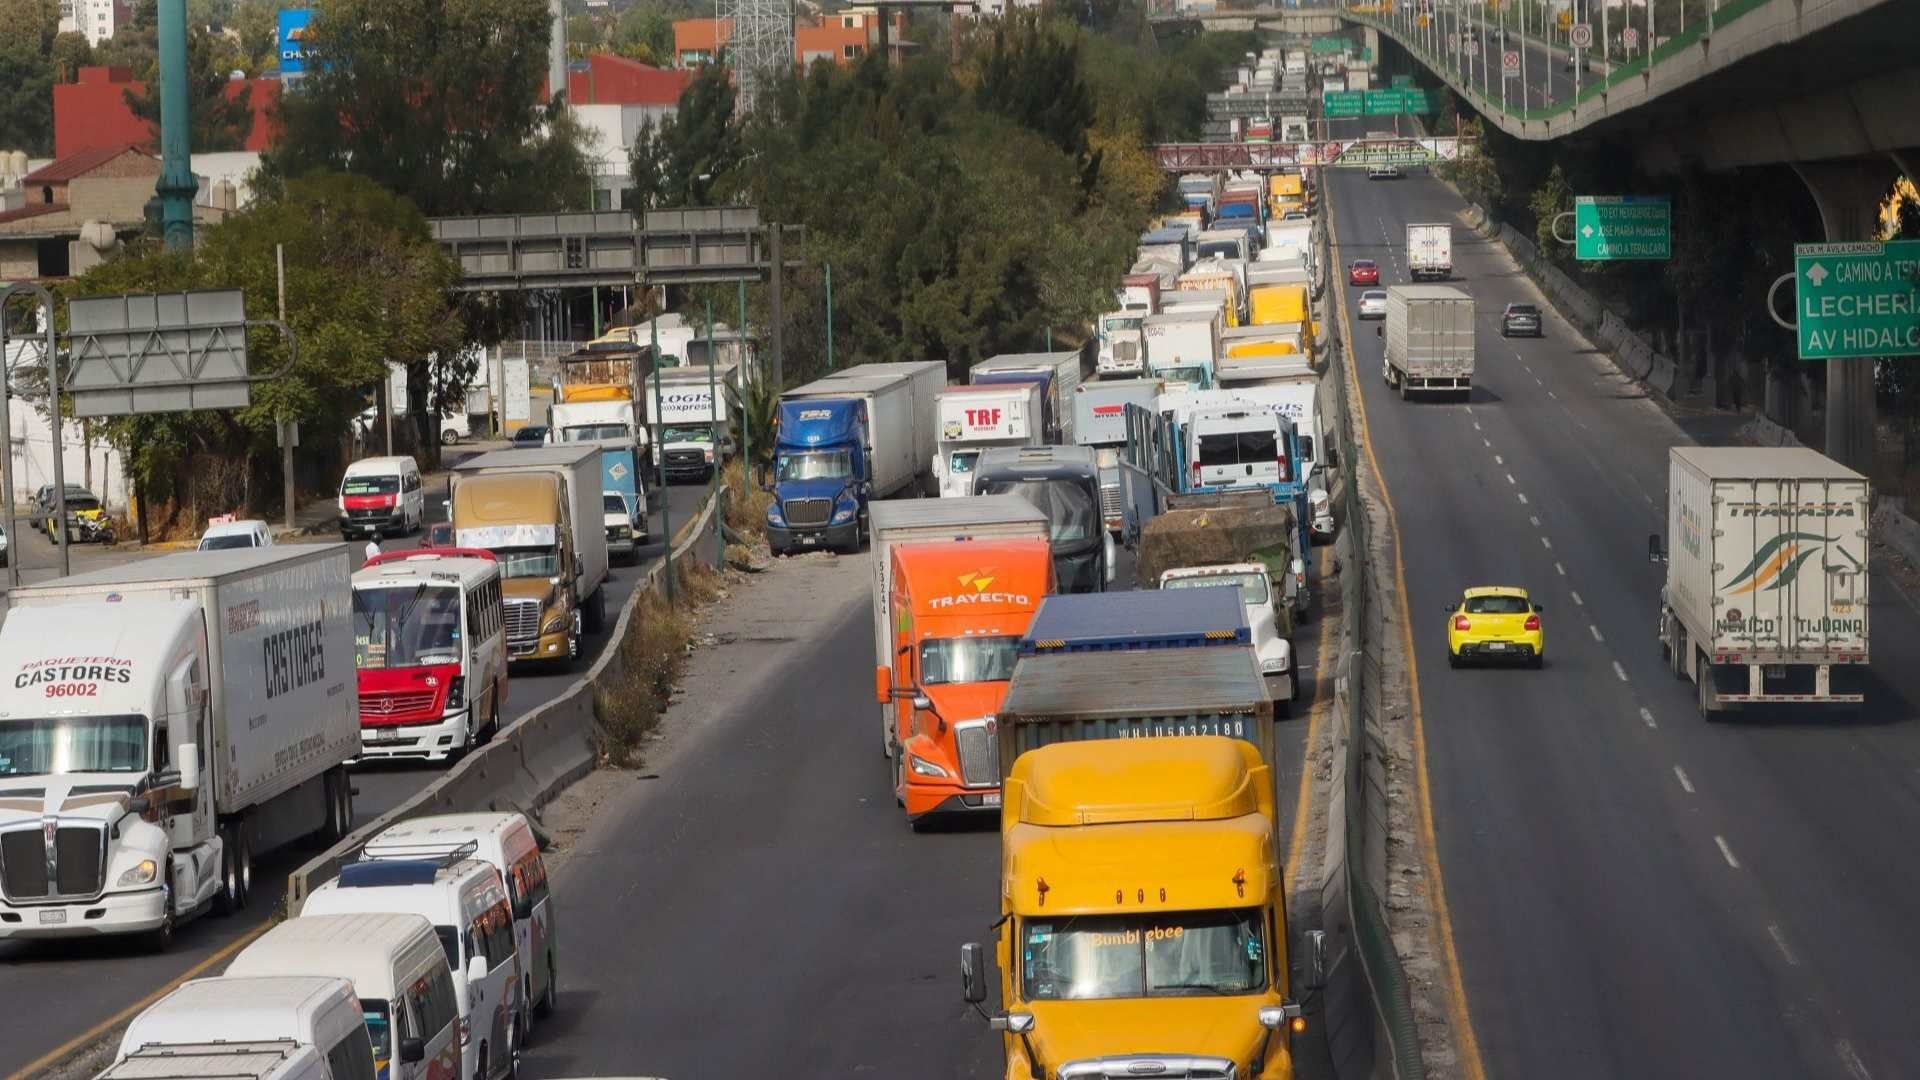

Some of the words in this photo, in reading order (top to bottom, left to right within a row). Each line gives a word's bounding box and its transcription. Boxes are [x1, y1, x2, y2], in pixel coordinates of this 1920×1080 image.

[1597, 243, 1622, 255] CAMINO
[1836, 262, 1880, 282] CAMINO
[1884, 261, 1893, 280] A
[1806, 289, 1920, 317] LECHERÍ
[1808, 329, 1836, 350] AV
[965, 408, 1001, 426] TRF
[929, 592, 1029, 609] TRAYECTO
[1799, 618, 1863, 633] TIJUANA
[22, 656, 132, 671] PAQUETERIA
[263, 619, 325, 700] CASTORES
[15, 665, 131, 689] CASTORES
[45, 683, 97, 698] 96002
